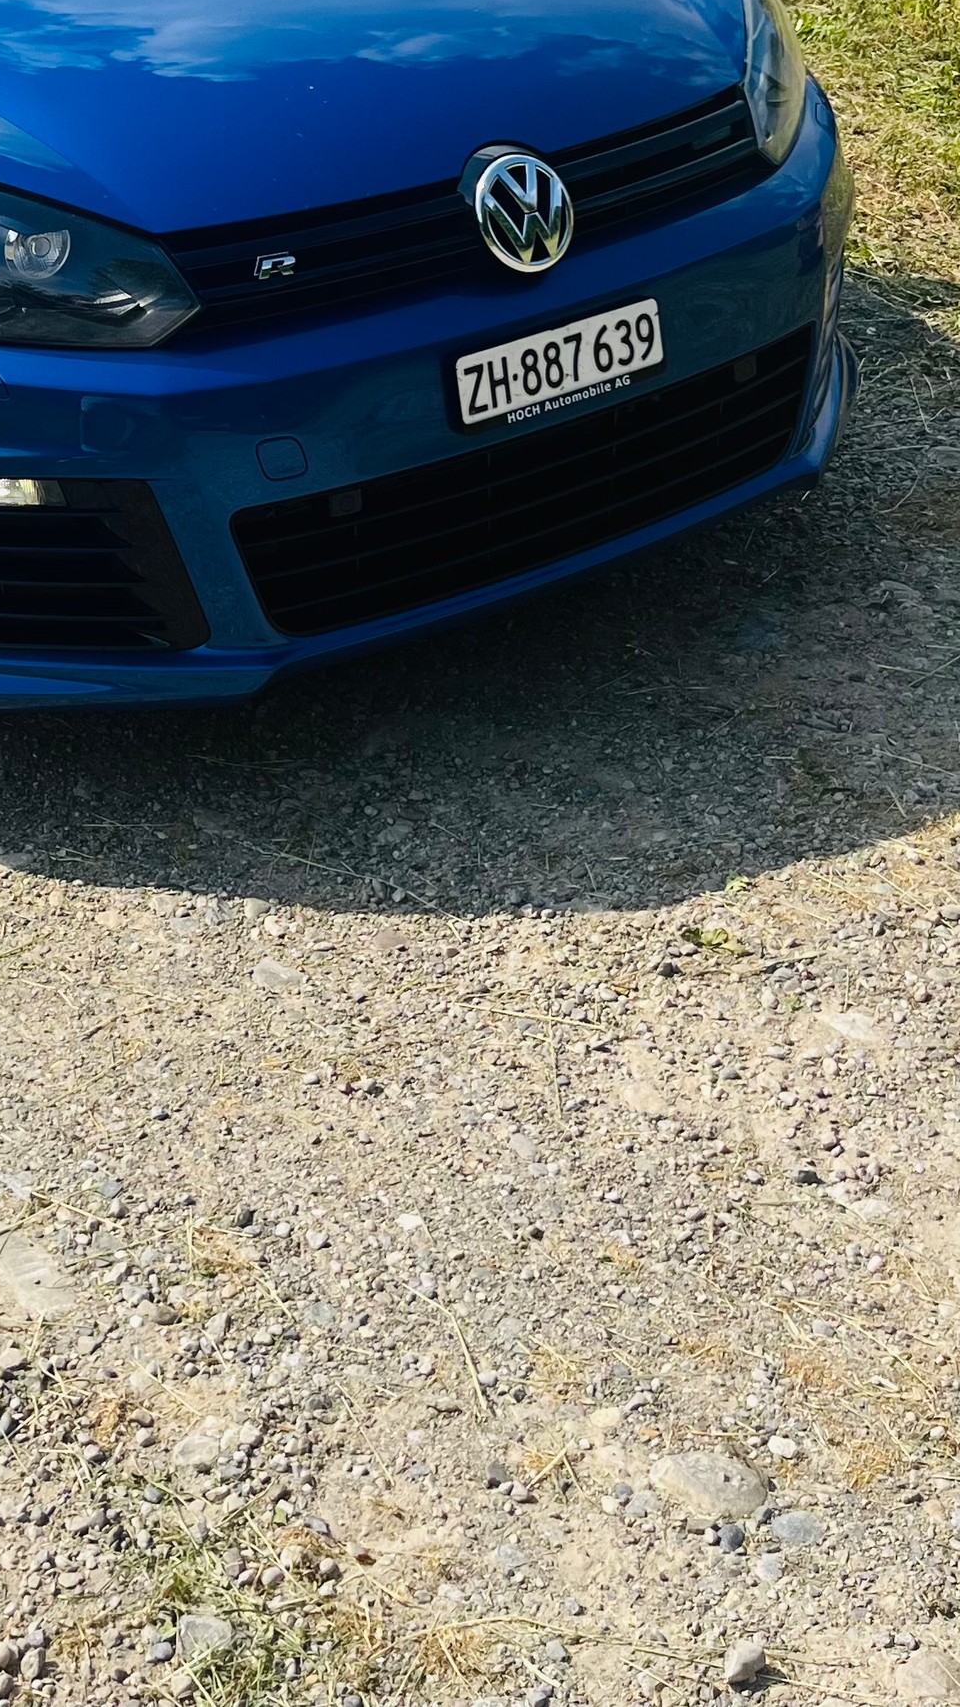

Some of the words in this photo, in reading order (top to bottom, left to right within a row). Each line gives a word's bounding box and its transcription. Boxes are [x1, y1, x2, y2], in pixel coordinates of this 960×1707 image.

[481, 160, 567, 268] VW
[254, 251, 296, 280] R
[507, 404, 541, 424] HOCH
[544, 382, 612, 412] Automobile
[615, 375, 631, 389] AG
